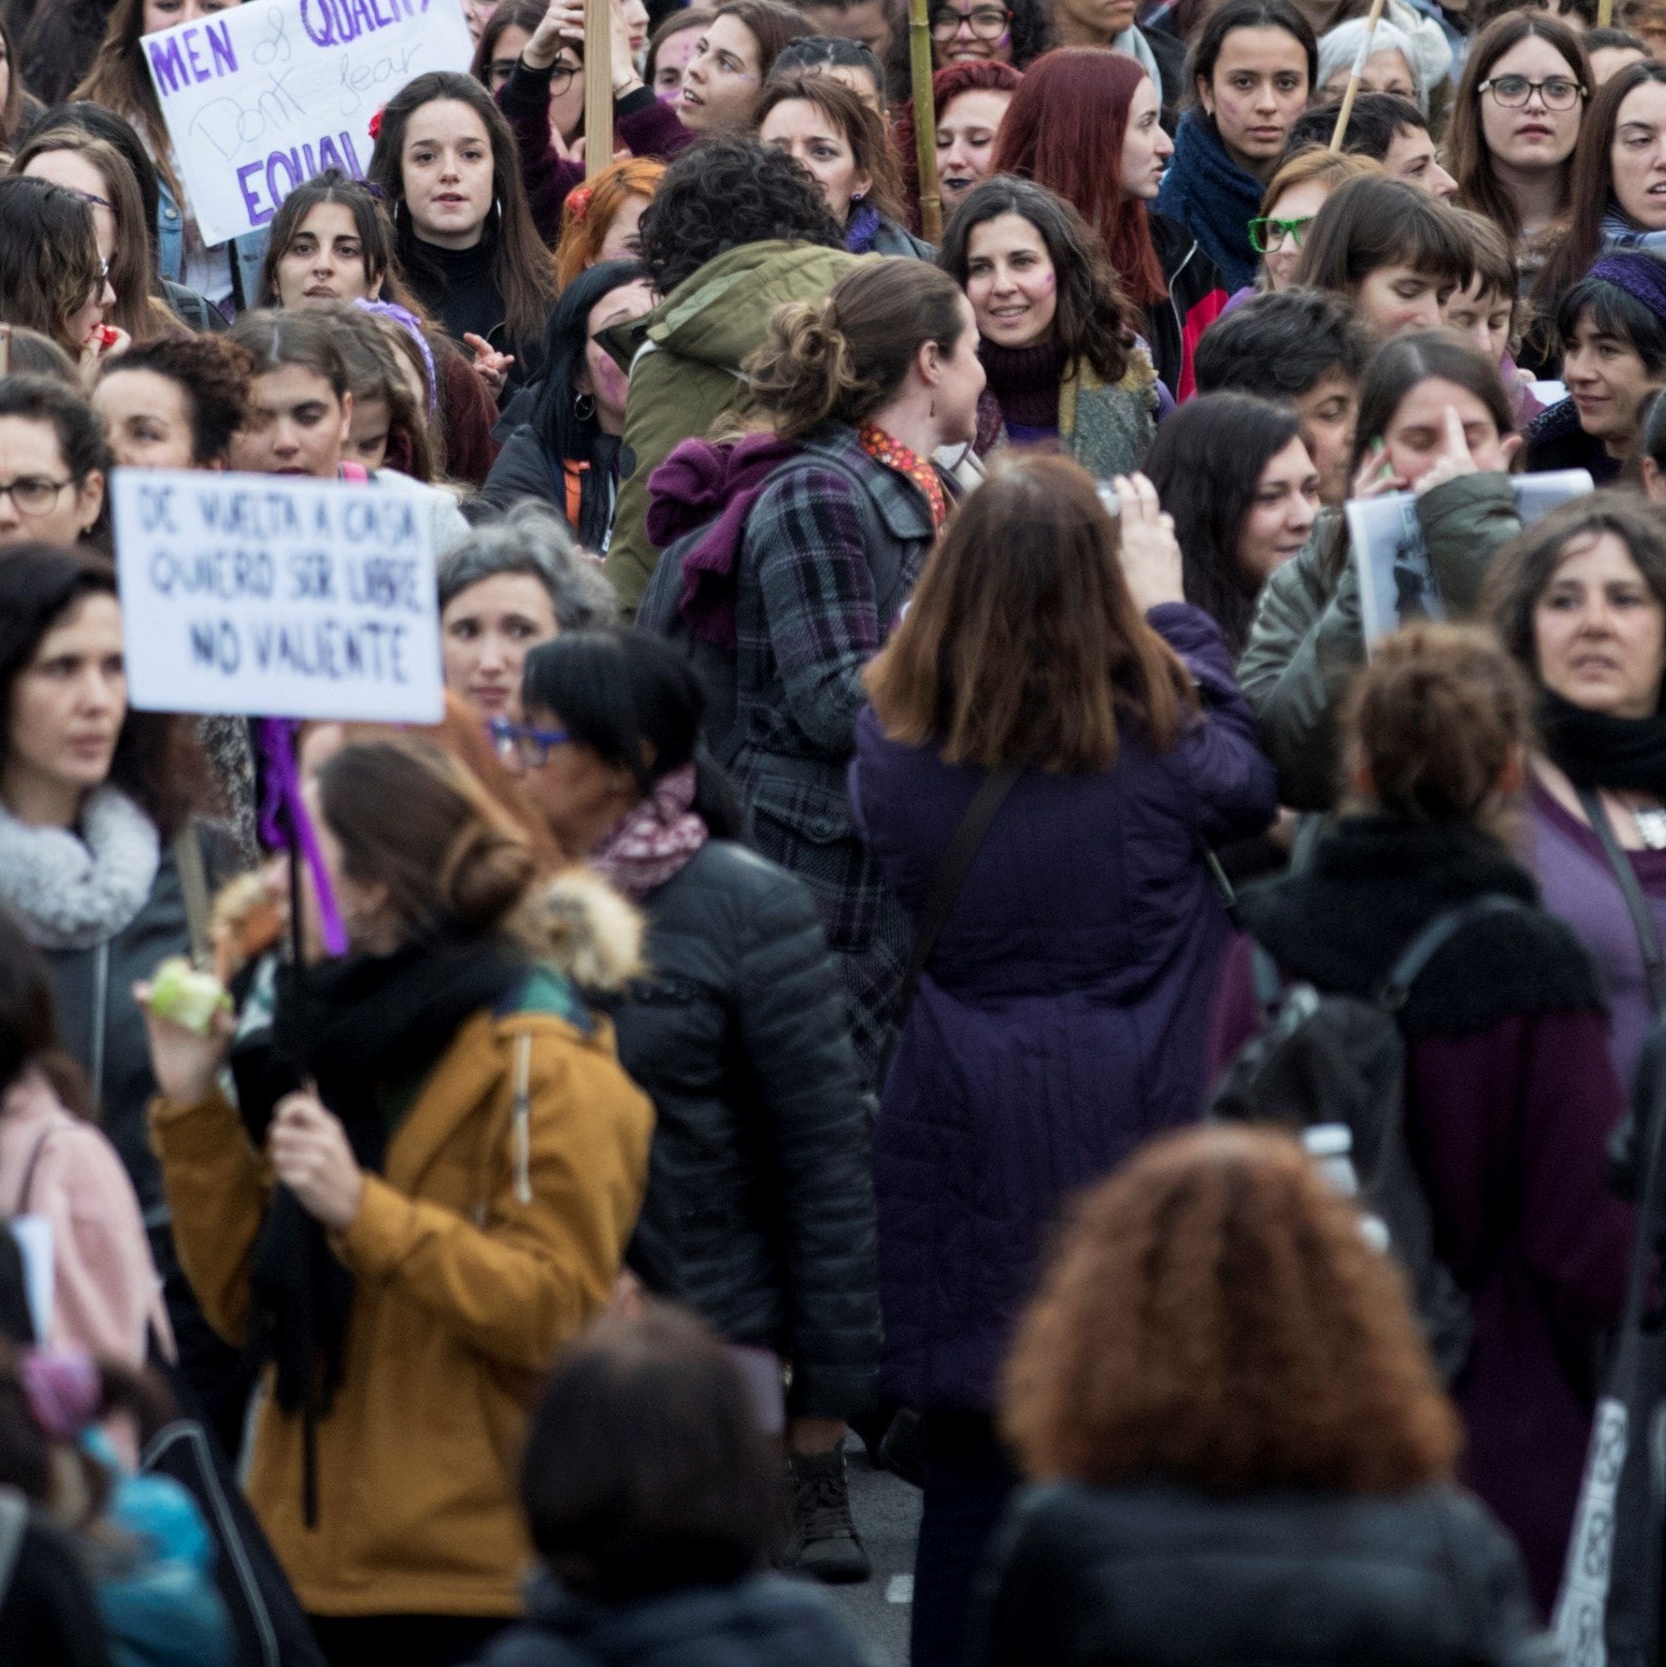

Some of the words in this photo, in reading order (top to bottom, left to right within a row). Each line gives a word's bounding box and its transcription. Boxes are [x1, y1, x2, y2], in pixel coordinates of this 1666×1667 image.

[149, 20, 239, 97] MEN
[252, 7, 292, 65] of
[339, 43, 423, 116] fear
[141, 485, 177, 533] DE
[197, 491, 300, 538] VUELTA
[316, 497, 332, 531] A
[345, 499, 421, 547] CASA
[150, 549, 274, 600] QUIERO
[189, 621, 240, 676] NO
[251, 619, 408, 684] VALIENTE
